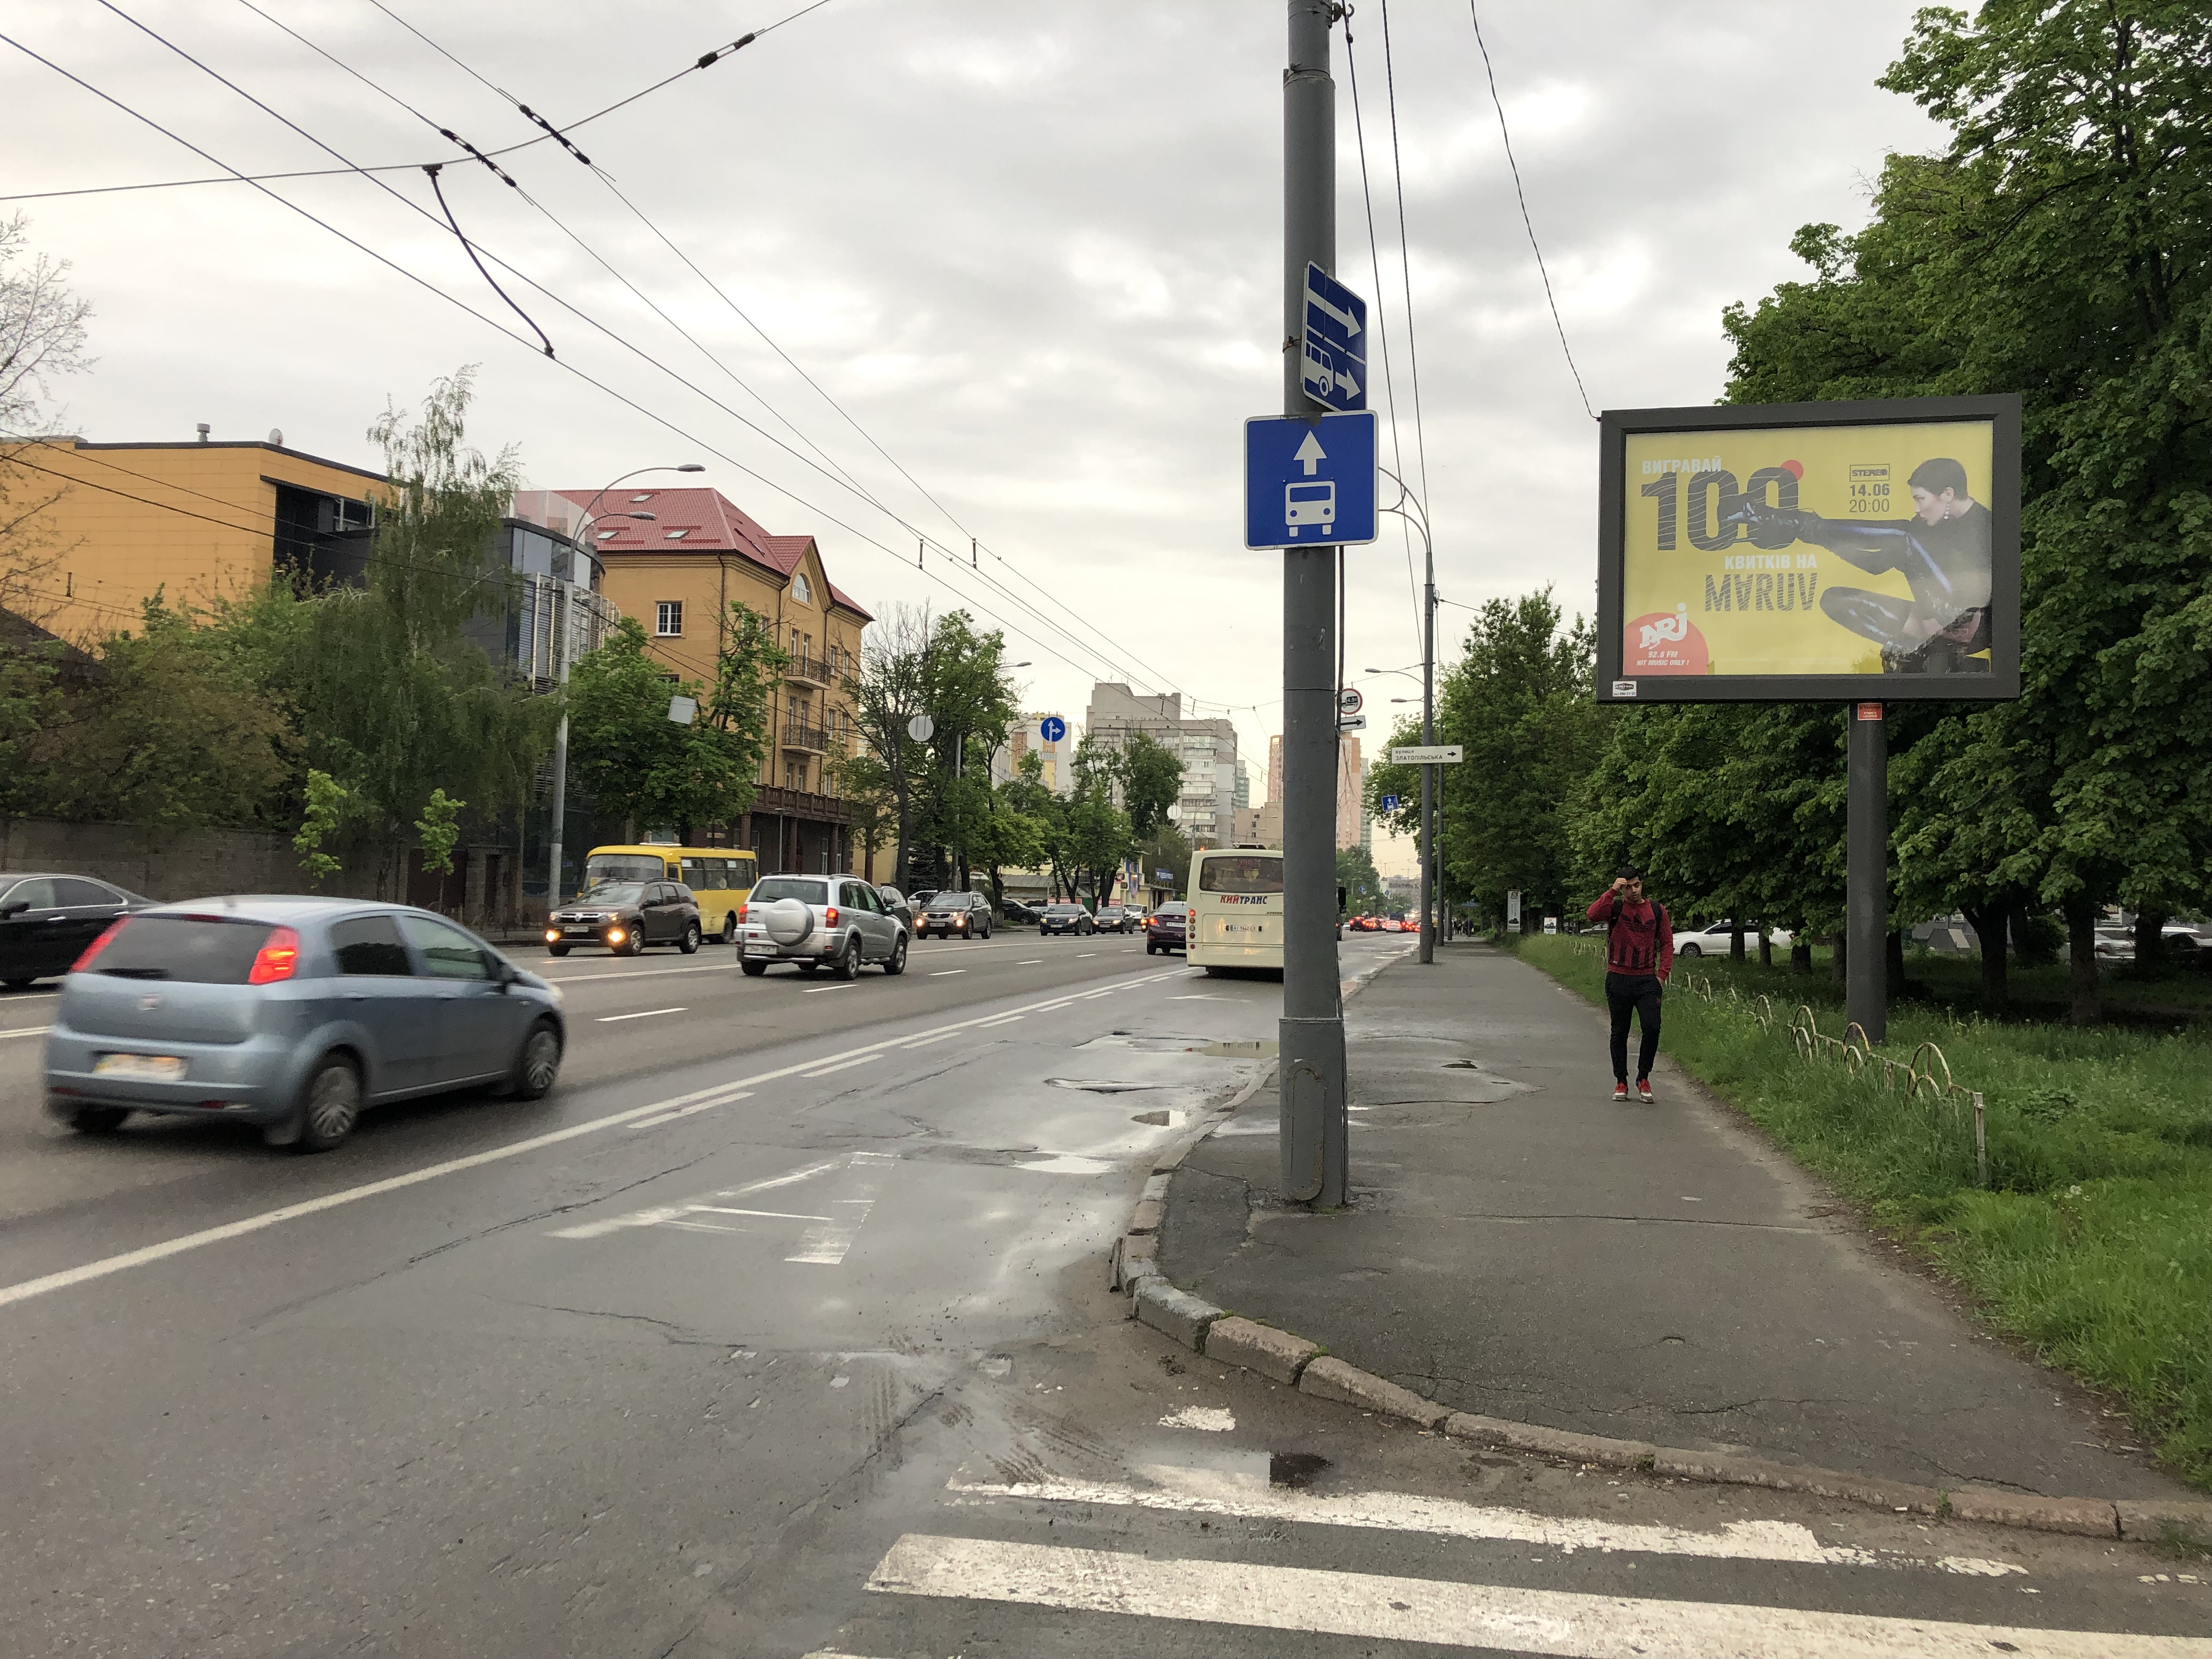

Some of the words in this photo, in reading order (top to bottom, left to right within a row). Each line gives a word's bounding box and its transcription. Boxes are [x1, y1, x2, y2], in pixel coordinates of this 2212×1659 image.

[1642, 455, 1722, 474] ВИГРАВАЙ
[1849, 483, 1890, 496] 14.06
[1641, 466, 1798, 551] 100
[1849, 498, 1889, 513] 20:00
[1725, 555, 1790, 569] КВИТКІВ
[1796, 554, 1817, 568] НА
